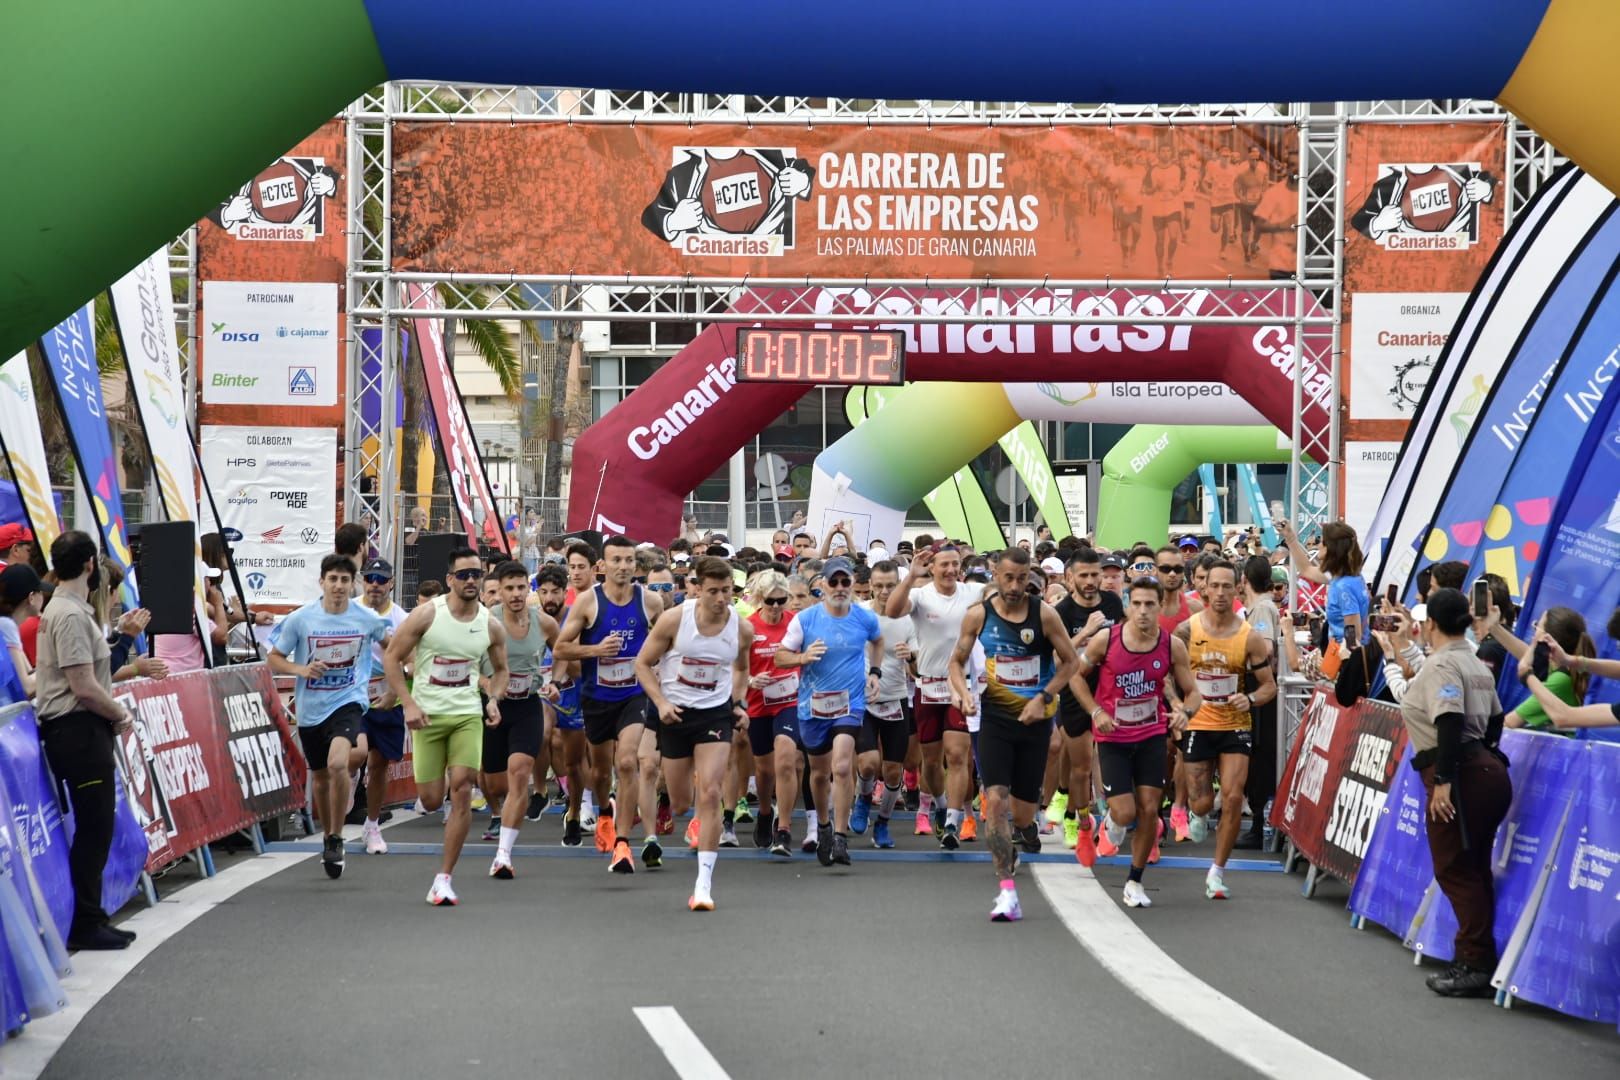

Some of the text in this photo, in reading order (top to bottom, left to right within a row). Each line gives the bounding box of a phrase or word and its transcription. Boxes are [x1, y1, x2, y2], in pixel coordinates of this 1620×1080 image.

[817, 152, 1005, 189] CARRERA DE
[262, 181, 296, 202] #C7CE
[714, 178, 759, 206] #C7CE
[1412, 189, 1450, 211] #C7CE
[817, 194, 1039, 231] LAS EMPRESAS
[686, 235, 780, 255] Canarias7
[817, 238, 1036, 257] LAS PALMAS DE GRAN CANARIA
[247, 293, 294, 303] PATROCINAN
[814, 287, 1210, 354] Canarias7
[1400, 305, 1441, 316] ORGANIZA
[137, 283, 160, 364] Gran
[290, 328, 329, 339] cajamar
[747, 333, 893, 381] 0:00:02
[211, 373, 259, 387] Binter
[293, 386, 314, 394] ALDI
[1564, 343, 1620, 423] INST
[1111, 382, 1141, 397] Isla
[1147, 383, 1223, 400] Europea
[627, 356, 737, 461] Canaria
[247, 435, 292, 446] COLABORAN
[227, 458, 257, 467] HPS
[1129, 431, 1172, 474] Binter
[270, 491, 308, 500] POWER
[287, 500, 308, 509] ADE
[234, 558, 306, 568] ARTNER SOLIDARIO
[1115, 670, 1145, 688] 3COM
[228, 730, 291, 800] START
[1324, 776, 1389, 861] START
